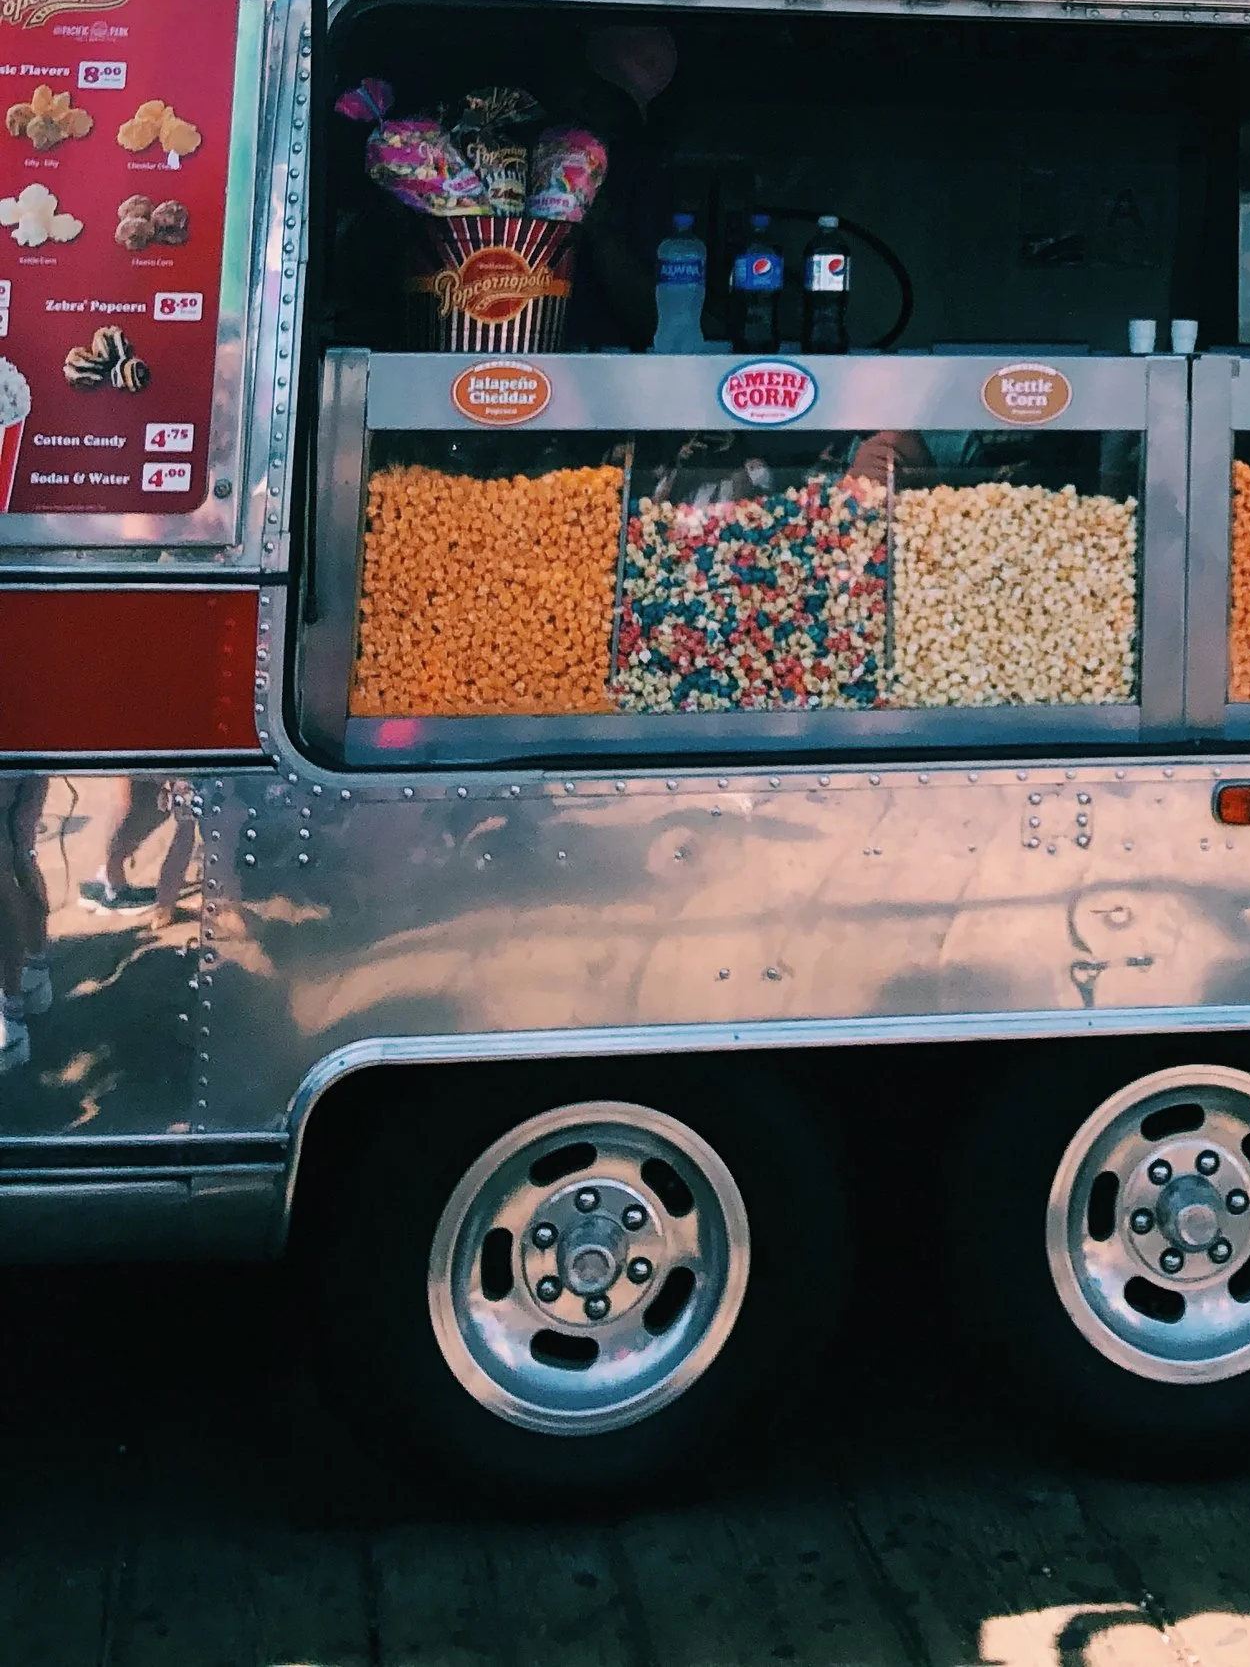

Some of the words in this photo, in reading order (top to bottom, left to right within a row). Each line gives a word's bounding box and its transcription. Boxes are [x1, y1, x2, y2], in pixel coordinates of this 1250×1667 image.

[20, 64, 70, 77] Flavors
[83, 66, 122, 84] 8.00
[434, 265, 552, 317] Popcornopolis
[90, 300, 147, 314] Popcorn
[159, 297, 198, 315] 8.50
[468, 375, 538, 392] Jalapeño
[728, 371, 808, 392] AMERI
[1001, 378, 1054, 393] Kettle
[469, 390, 537, 405] Cheddar
[733, 387, 802, 409] CORN
[1005, 392, 1049, 407] Corn
[33, 433, 81, 447] Cotton
[83, 434, 127, 449] Candy
[150, 428, 189, 448] 4.75
[30, 471, 70, 484] Sodas
[73, 472, 87, 485] &
[88, 472, 131, 485] Water
[147, 468, 186, 488] 4.00
